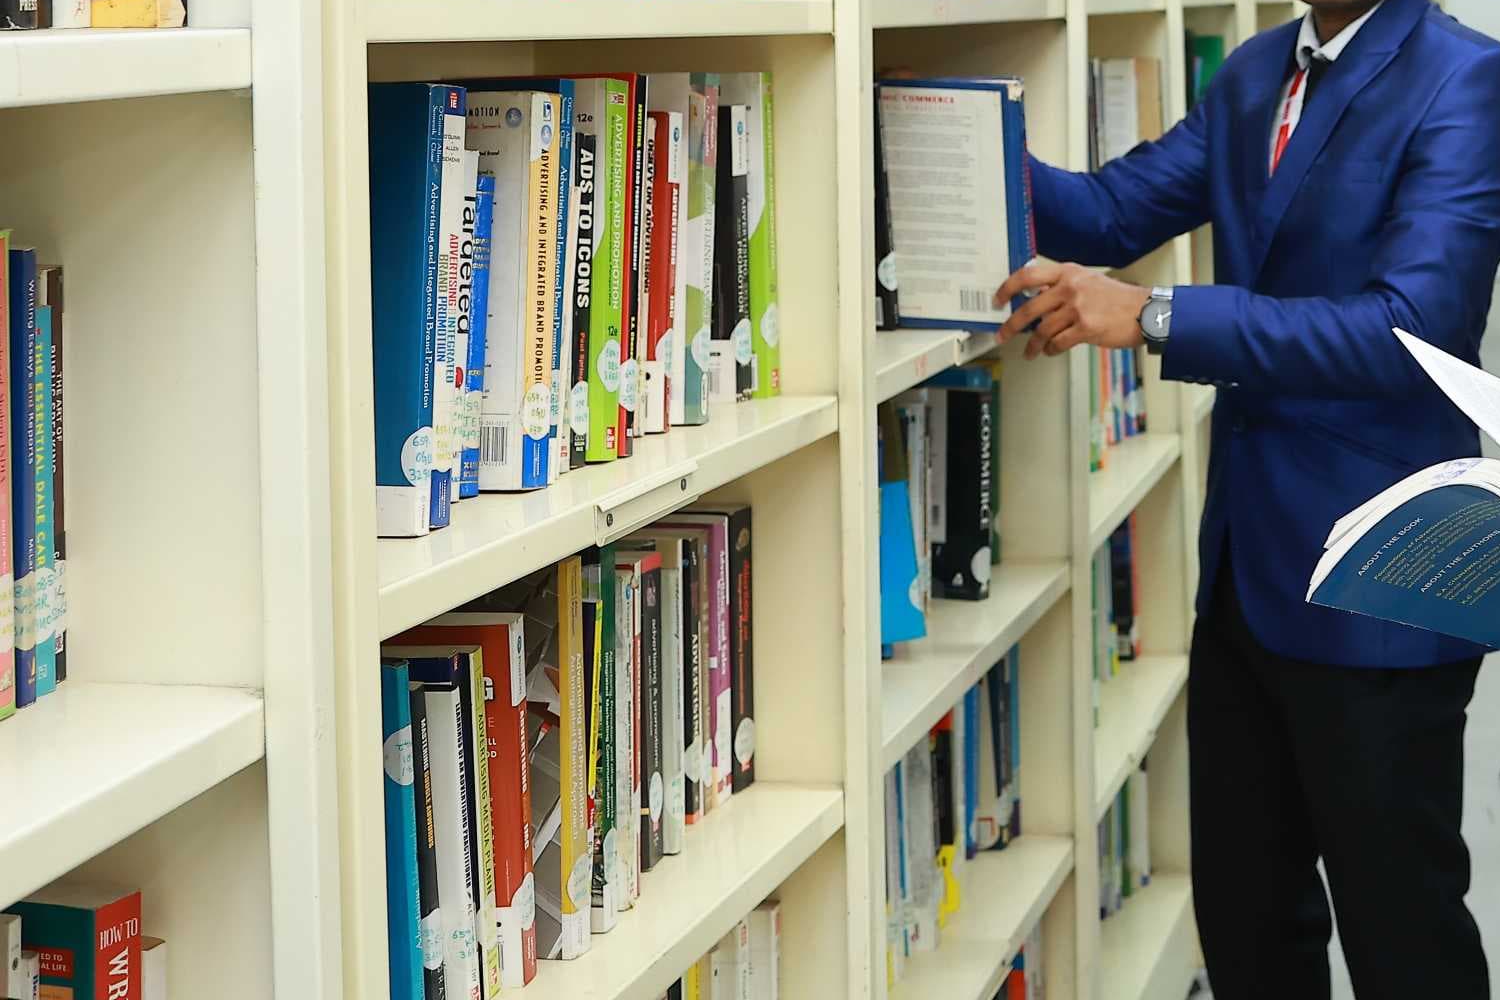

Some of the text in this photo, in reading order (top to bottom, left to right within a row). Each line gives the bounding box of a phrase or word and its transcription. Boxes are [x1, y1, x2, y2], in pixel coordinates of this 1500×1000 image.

[576, 113, 594, 123] 12e
[540, 148, 551, 211] ADVERTISING
[556, 166, 568, 221] Advertising
[646, 186, 655, 205] ON
[539, 216, 548, 235] AND
[576, 149, 594, 309] ADS TO ICONS
[611, 114, 623, 310] ADVERTISING AND PROMOTION
[456, 195, 477, 335] Targeted
[536, 239, 547, 296] INTEGRATED
[668, 186, 679, 319] ADVERTISING IMC
[736, 240, 746, 313] PROMOTION
[26, 279, 35, 328] Writing
[422, 182, 440, 409] Advertising and Integrated Brand Promotion
[436, 254, 449, 362] BRAND PROMOTION
[446, 234, 459, 383] ADVERTISING INTEGRATED
[535, 300, 545, 332] BRAND
[26, 333, 35, 378] Essays
[534, 337, 544, 384] PROMOTI
[577, 354, 586, 381] Spring
[26, 413, 35, 465] Reports
[35, 344, 47, 568] THE ESSENTIAL DALE CAR
[57, 427, 63, 442] OF
[979, 403, 991, 530] eCOMMERCE
[1357, 516, 1424, 577] ABOUT THE BOOK
[1420, 569, 1447, 593] ABOUT
[1446, 554, 1464, 570] THE
[650, 618, 659, 684] advertising
[574, 652, 583, 724] Advertising
[455, 703, 463, 748] LEARNINGS
[651, 700, 660, 768] promotions
[420, 717, 435, 849] MASTERING GOOGLE ADWORDS
[459, 774, 468, 828] ADVERTISING
[477, 713, 494, 896] ADVERTISING MEDIA PLANN
[519, 709, 530, 850] ADVERTISING IMC
[576, 751, 586, 830] Promotions
[569, 781, 579, 841] Approach
[462, 830, 471, 888] PRACTITIONER
[99, 917, 139, 951] HOW TO
[51, 963, 67, 973] LIFE
